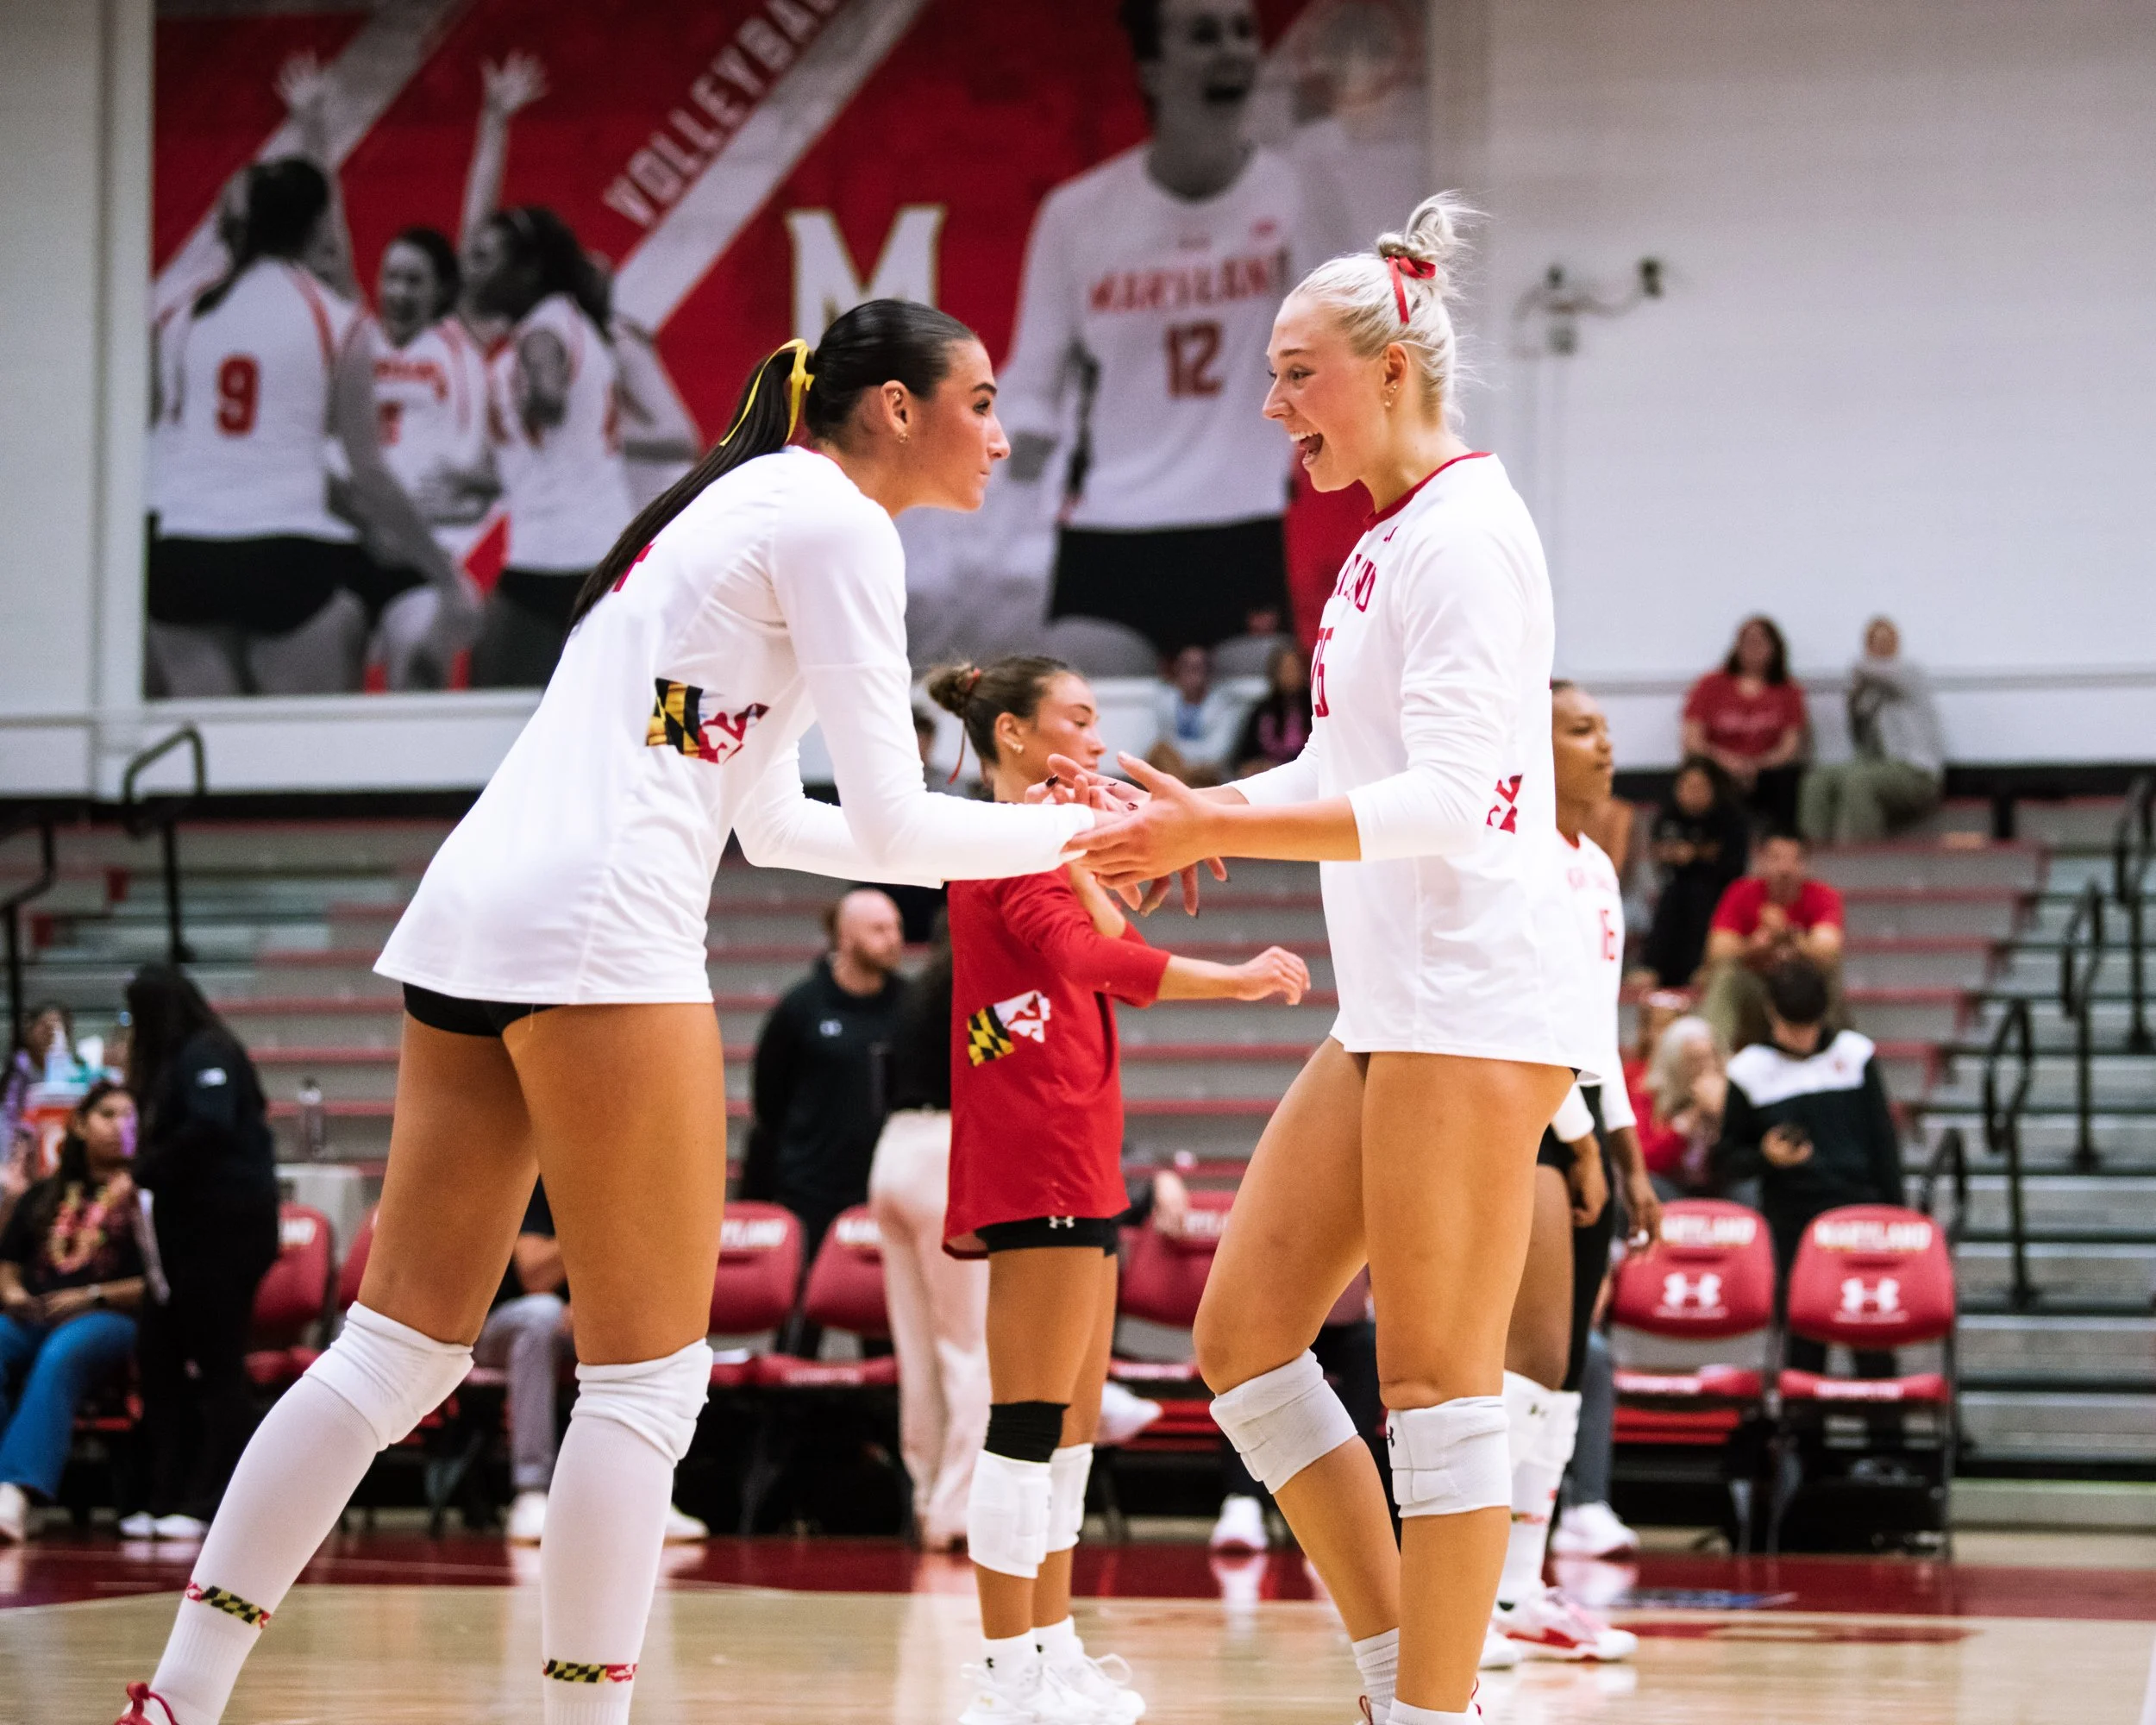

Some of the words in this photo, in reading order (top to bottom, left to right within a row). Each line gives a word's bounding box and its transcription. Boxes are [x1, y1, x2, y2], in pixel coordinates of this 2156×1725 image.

[603, 0, 837, 228] VOLLEYBA
[784, 204, 947, 352] M
[218, 355, 259, 435] 9
[1167, 323, 1223, 398] 12
